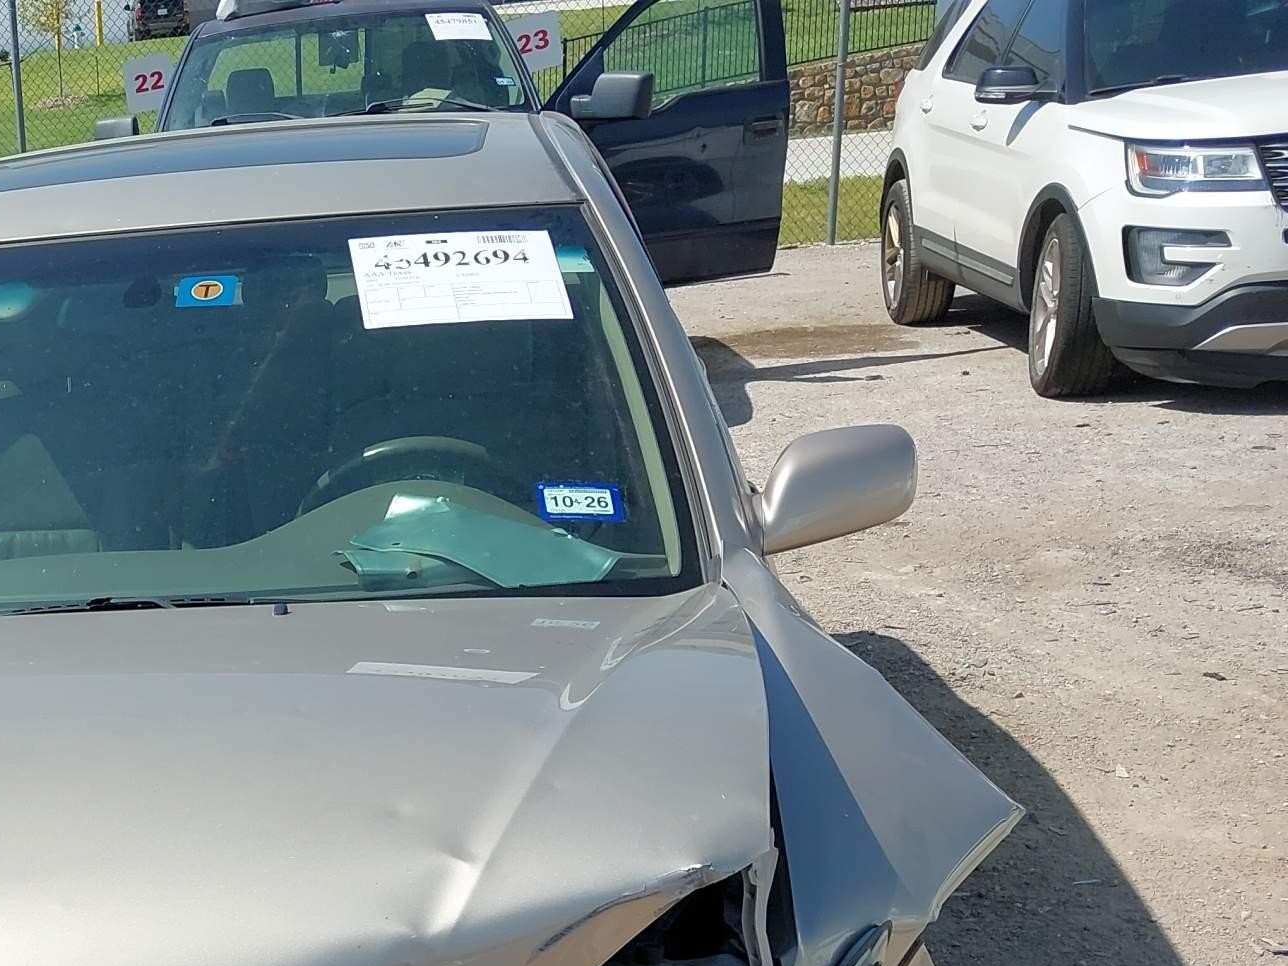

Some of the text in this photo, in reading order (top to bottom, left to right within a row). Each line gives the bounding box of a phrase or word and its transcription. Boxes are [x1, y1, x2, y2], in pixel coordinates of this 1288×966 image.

[517, 29, 550, 54] 23
[134, 71, 165, 94] 22
[374, 248, 530, 270] 45492694
[551, 495, 609, 508] 10 26
